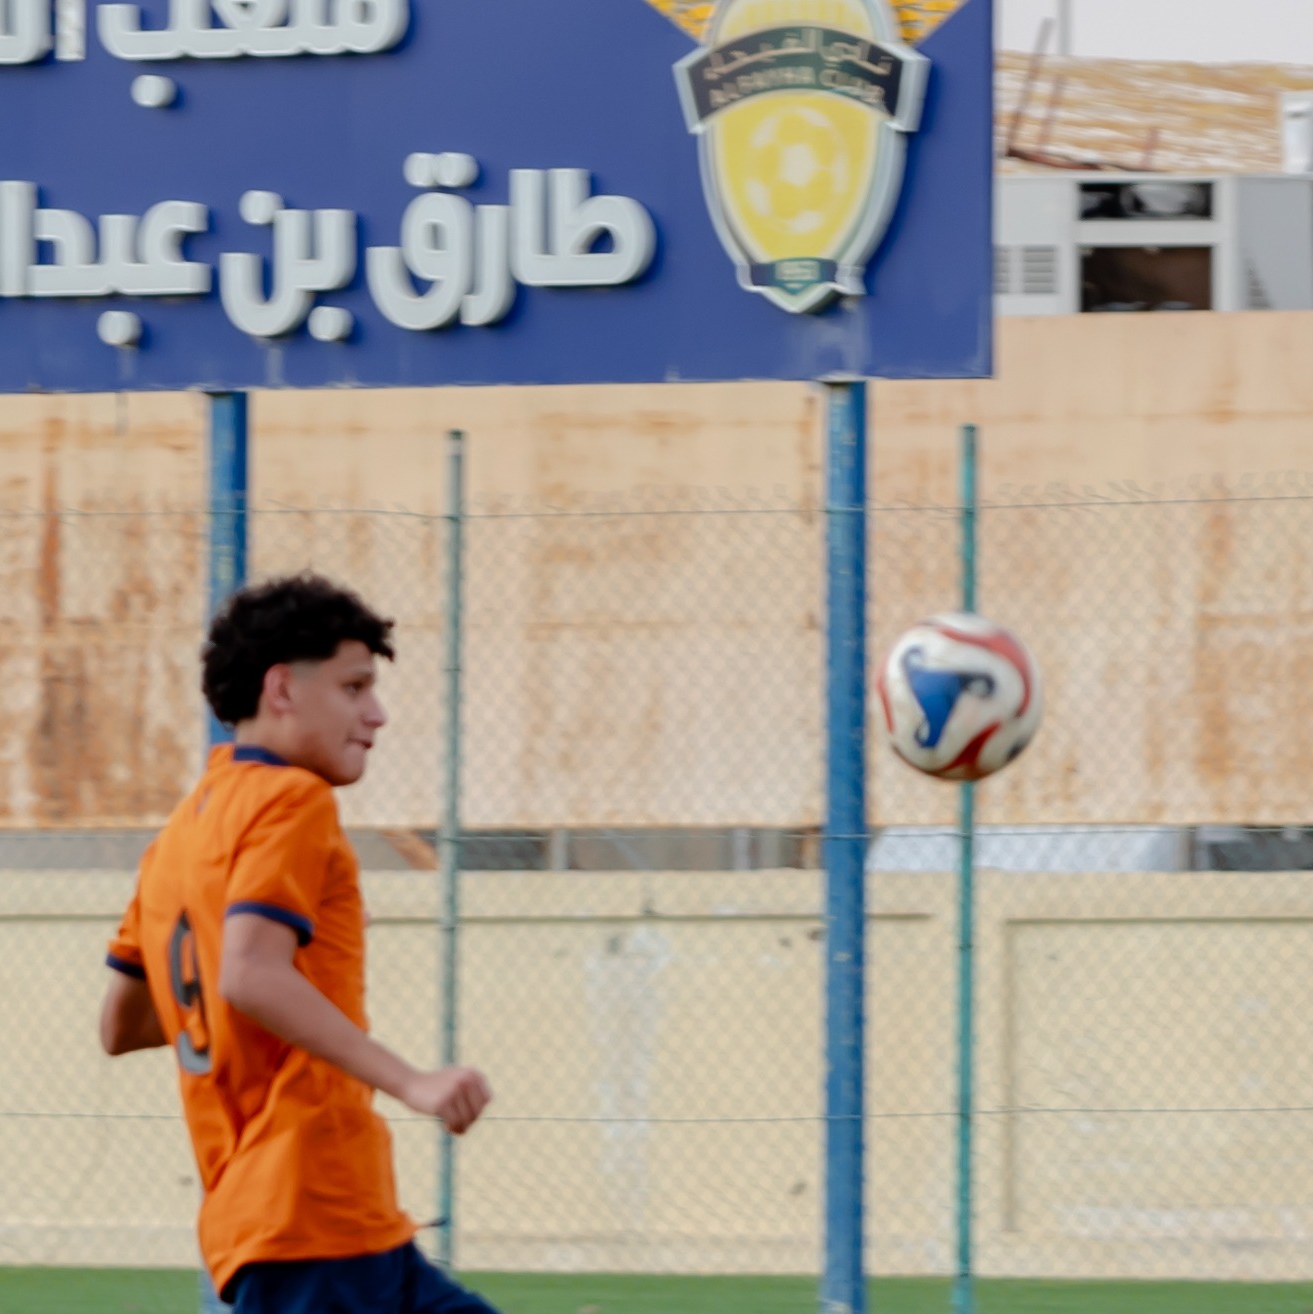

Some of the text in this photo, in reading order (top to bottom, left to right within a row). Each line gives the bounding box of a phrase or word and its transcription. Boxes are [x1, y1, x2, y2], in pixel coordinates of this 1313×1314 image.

[219, 189, 356, 342] بن
[367, 151, 657, 332] طارق
[170, 909, 212, 1073] 9
